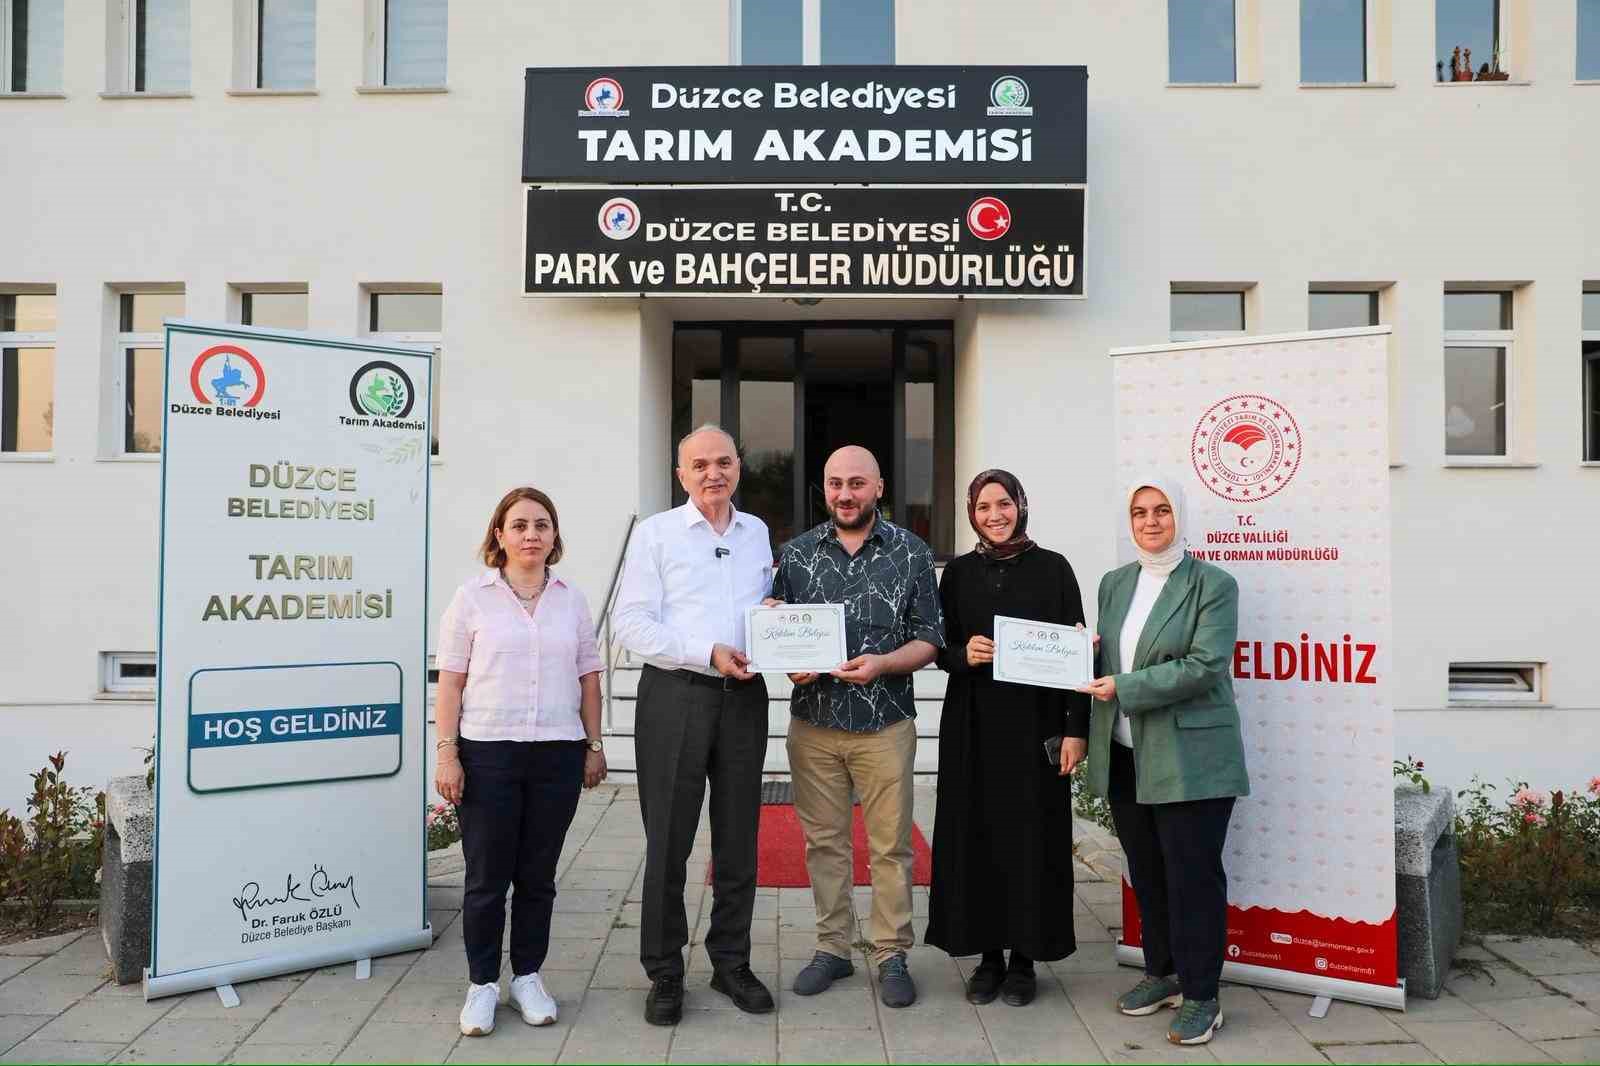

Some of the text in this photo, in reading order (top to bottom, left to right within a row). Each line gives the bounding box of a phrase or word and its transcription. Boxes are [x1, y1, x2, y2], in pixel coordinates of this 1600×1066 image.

[652, 81, 955, 114] Düzce Belediyesi
[579, 129, 1031, 161] TARIM AKADEMİSİ
[775, 193, 831, 211] T.C.
[646, 218, 959, 242] DÜZCE BELEDİYESİ
[535, 245, 1074, 293] PARK ve BAHÇELER MÜDÜRLÜĞÜ
[171, 403, 281, 421] Düzce Belediyesi
[339, 416, 426, 431] Tarım Akademisi
[249, 460, 357, 492] DÜZCE
[227, 496, 375, 521] BELEDİYESİ
[1237, 515, 1256, 526] T.C.
[1206, 530, 1288, 544] DÜZCE VALİLİĞİ
[1208, 550, 1220, 561] VE
[1223, 549, 1263, 561] ORMAN
[1266, 547, 1338, 561] MÜDÜRLÜĞÜ
[249, 554, 353, 581] TARIM
[201, 588, 393, 622] AKADEMİSİ
[1233, 633, 1376, 684] ELDİNİZ
[205, 708, 387, 741] HOŞ GELDİNİZ
[252, 904, 342, 928] Dr. Faruk ÖZLÜ
[274, 924, 313, 938] Belediye
[316, 918, 351, 932] Başkanı
